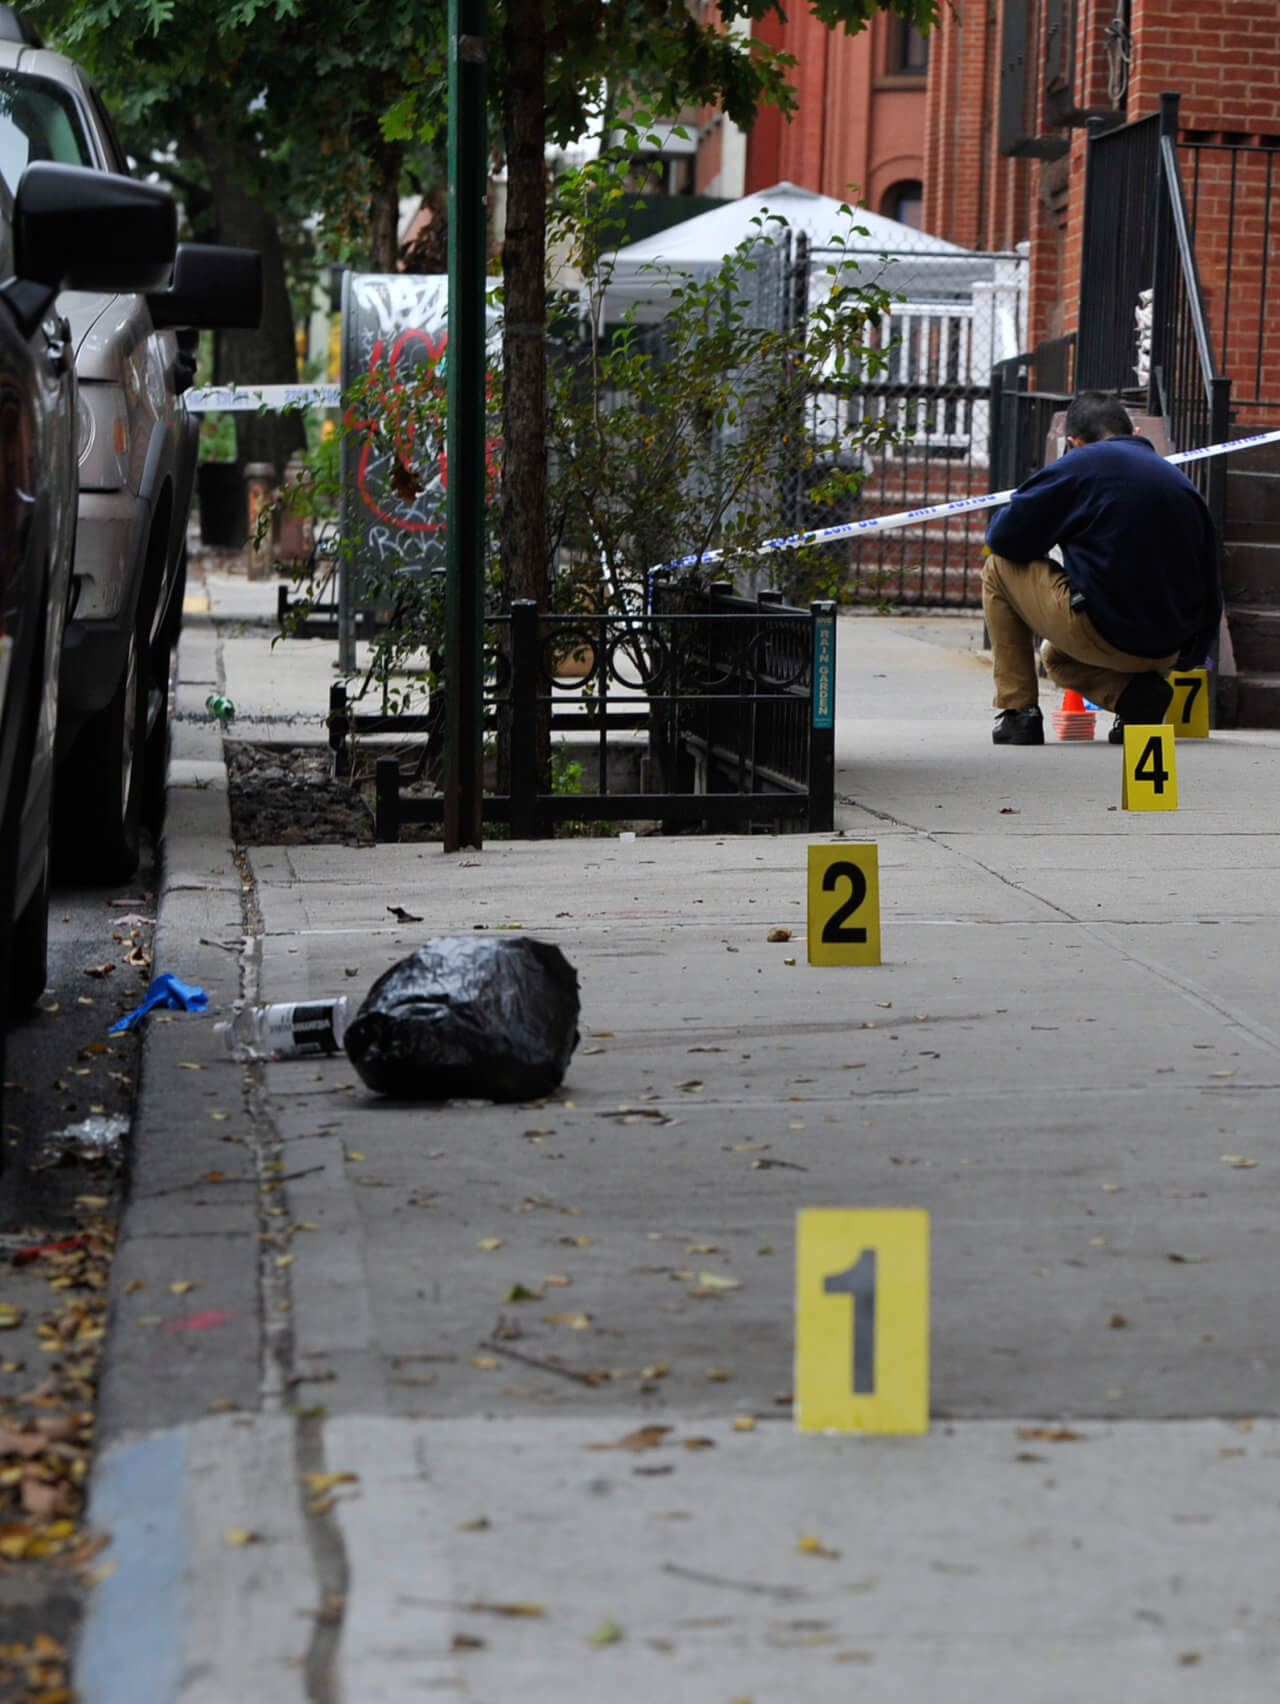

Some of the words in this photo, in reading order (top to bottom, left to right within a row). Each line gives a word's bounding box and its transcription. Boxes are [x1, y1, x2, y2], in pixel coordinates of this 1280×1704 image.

[819, 629, 830, 663] RAIN
[818, 665, 829, 716] GARDEN
[1174, 677, 1202, 724] 7
[1134, 735, 1169, 795] 4
[821, 860, 867, 944] 2
[823, 1248, 877, 1396] 1
